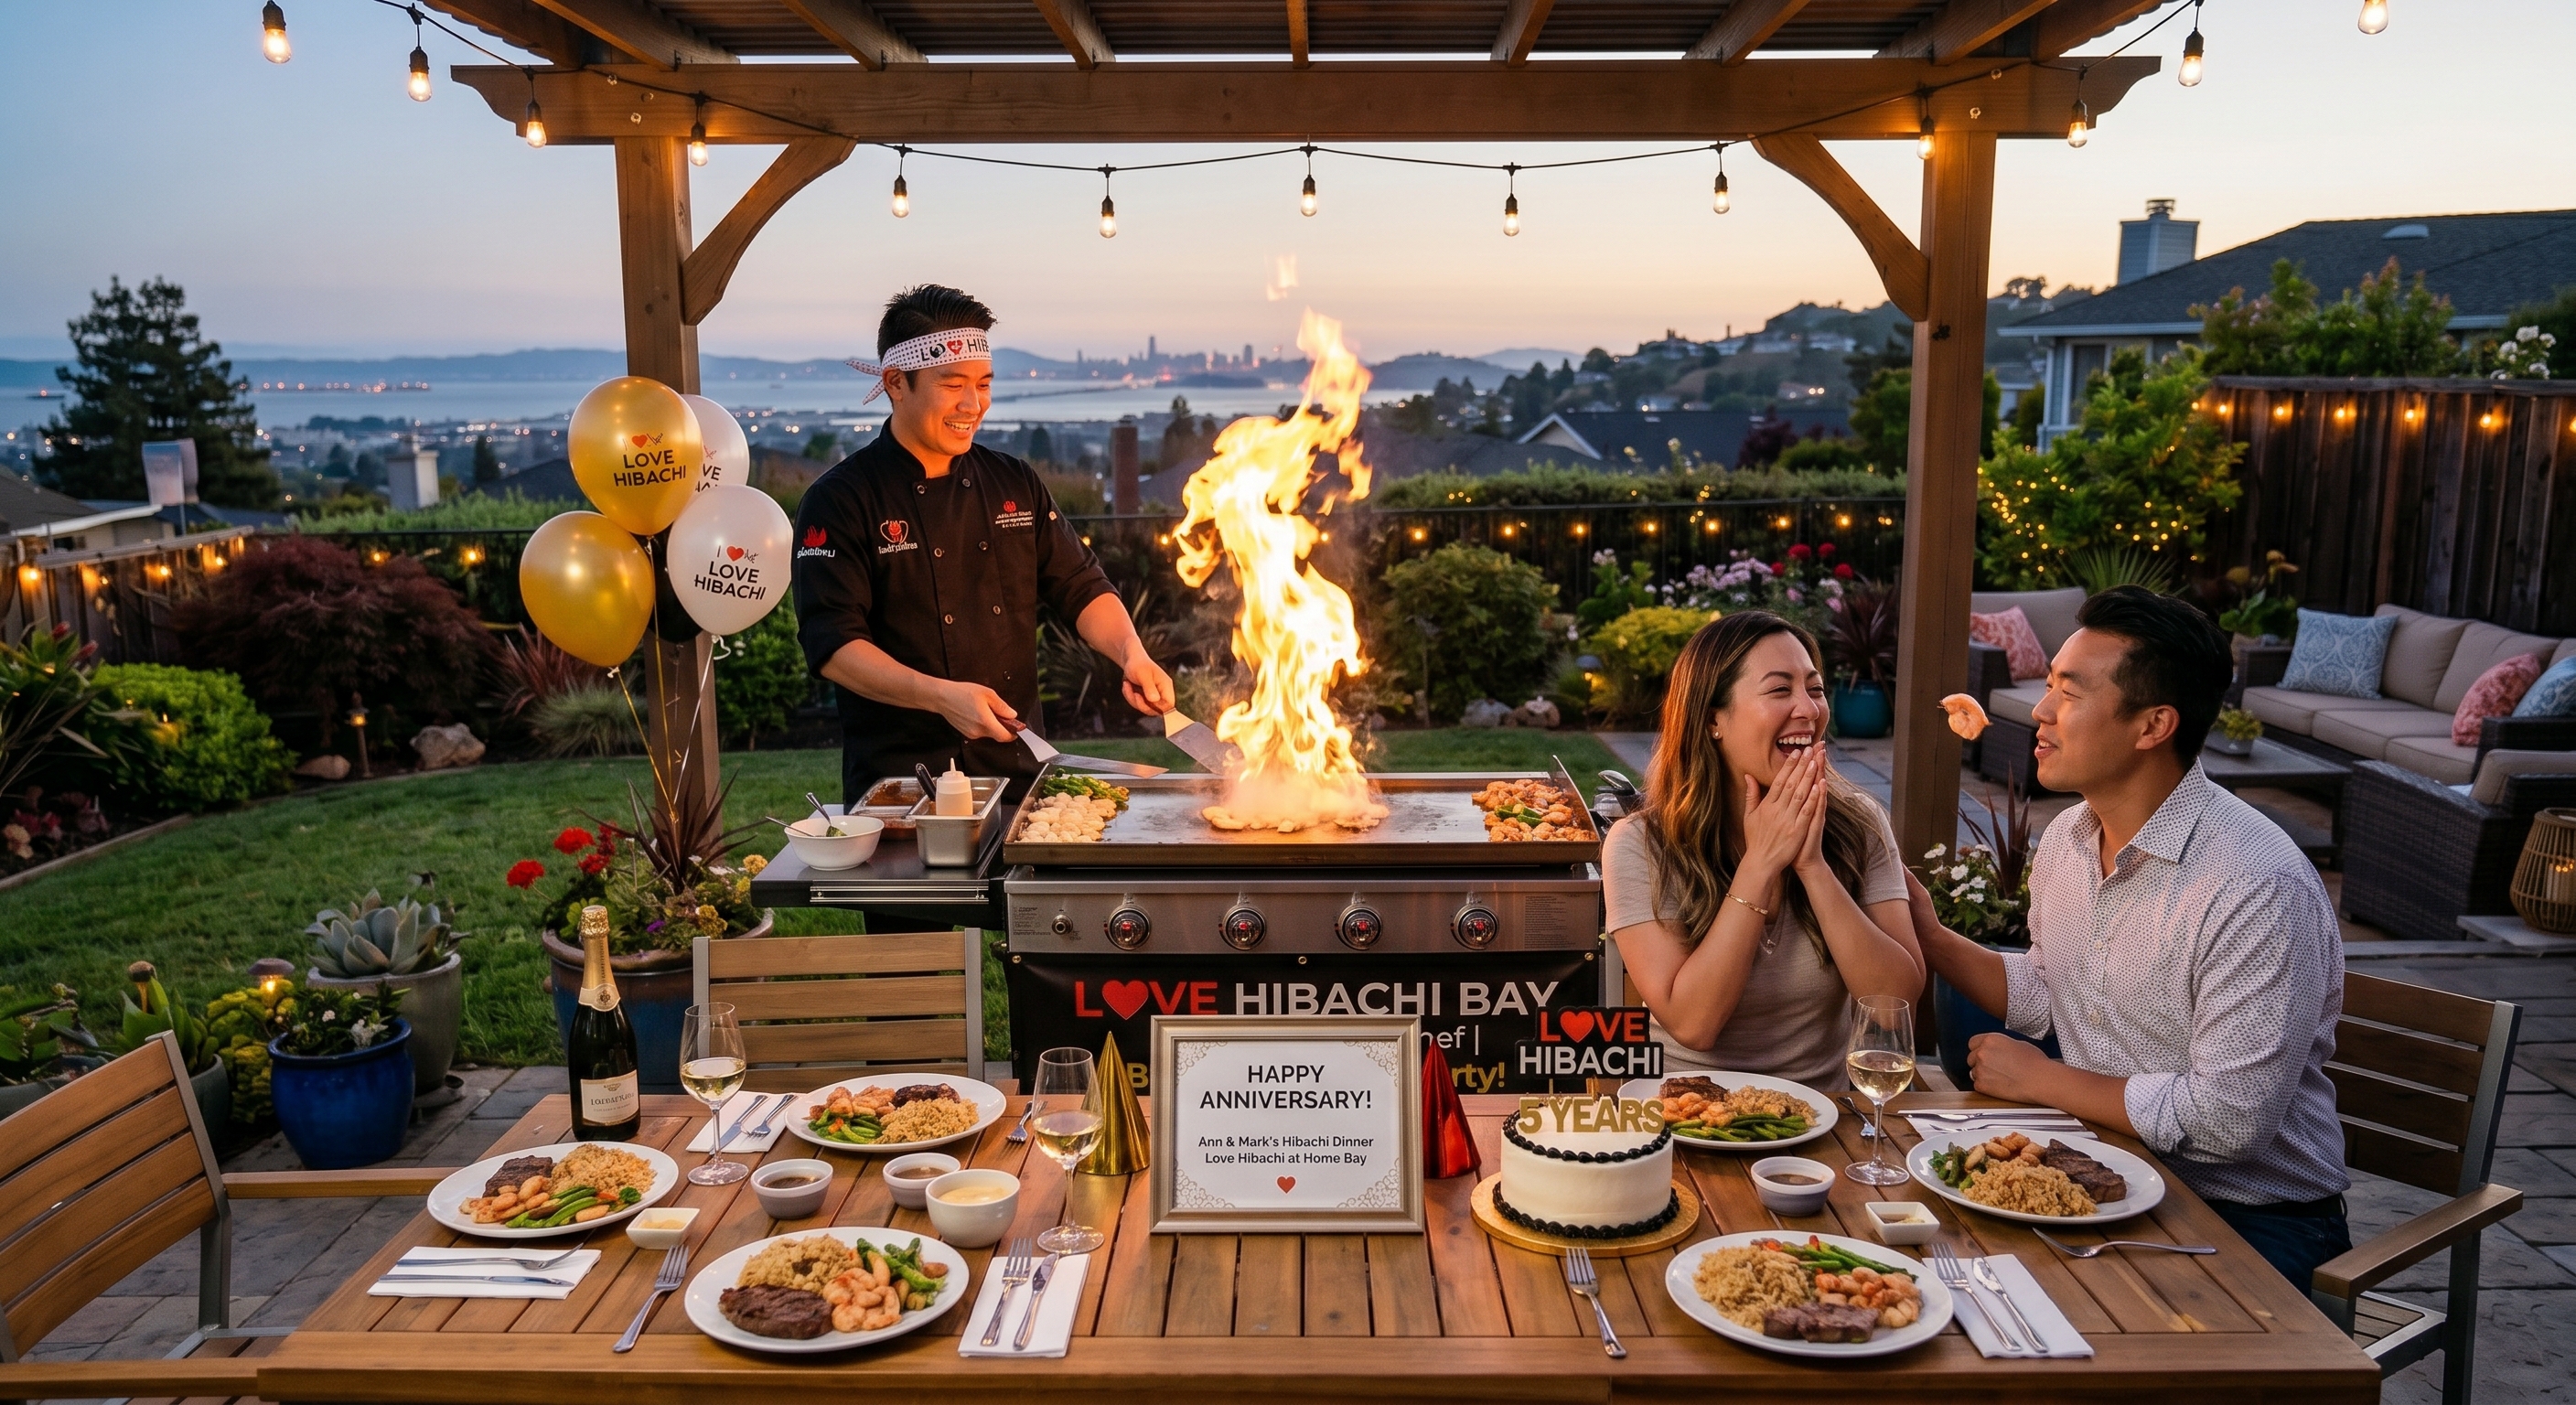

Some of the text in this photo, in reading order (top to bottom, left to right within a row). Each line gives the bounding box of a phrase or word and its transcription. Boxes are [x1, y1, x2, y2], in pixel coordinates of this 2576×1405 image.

[623, 449, 675, 469] LOVE
[613, 465, 686, 487] HIBACHI
[703, 463, 722, 481] VE
[709, 561, 759, 584] LOVE
[694, 574, 767, 600] HIBACHI
[1236, 981, 1441, 1015] HIBACHI
[1459, 981, 1559, 1015] BAY
[1519, 1046, 1660, 1076] HIBACHI
[1248, 1065, 1326, 1083] HAPPY
[1452, 1062, 1506, 1093] rty!
[1199, 1090, 1371, 1110] ANNIVERSARY!
[1518, 1097, 1666, 1134] 5 YEARS
[1198, 1136, 1374, 1147] Ann & Mark's Hibachi Dinner
[1205, 1153, 1368, 1166] Love Hibachi at Home Bay
